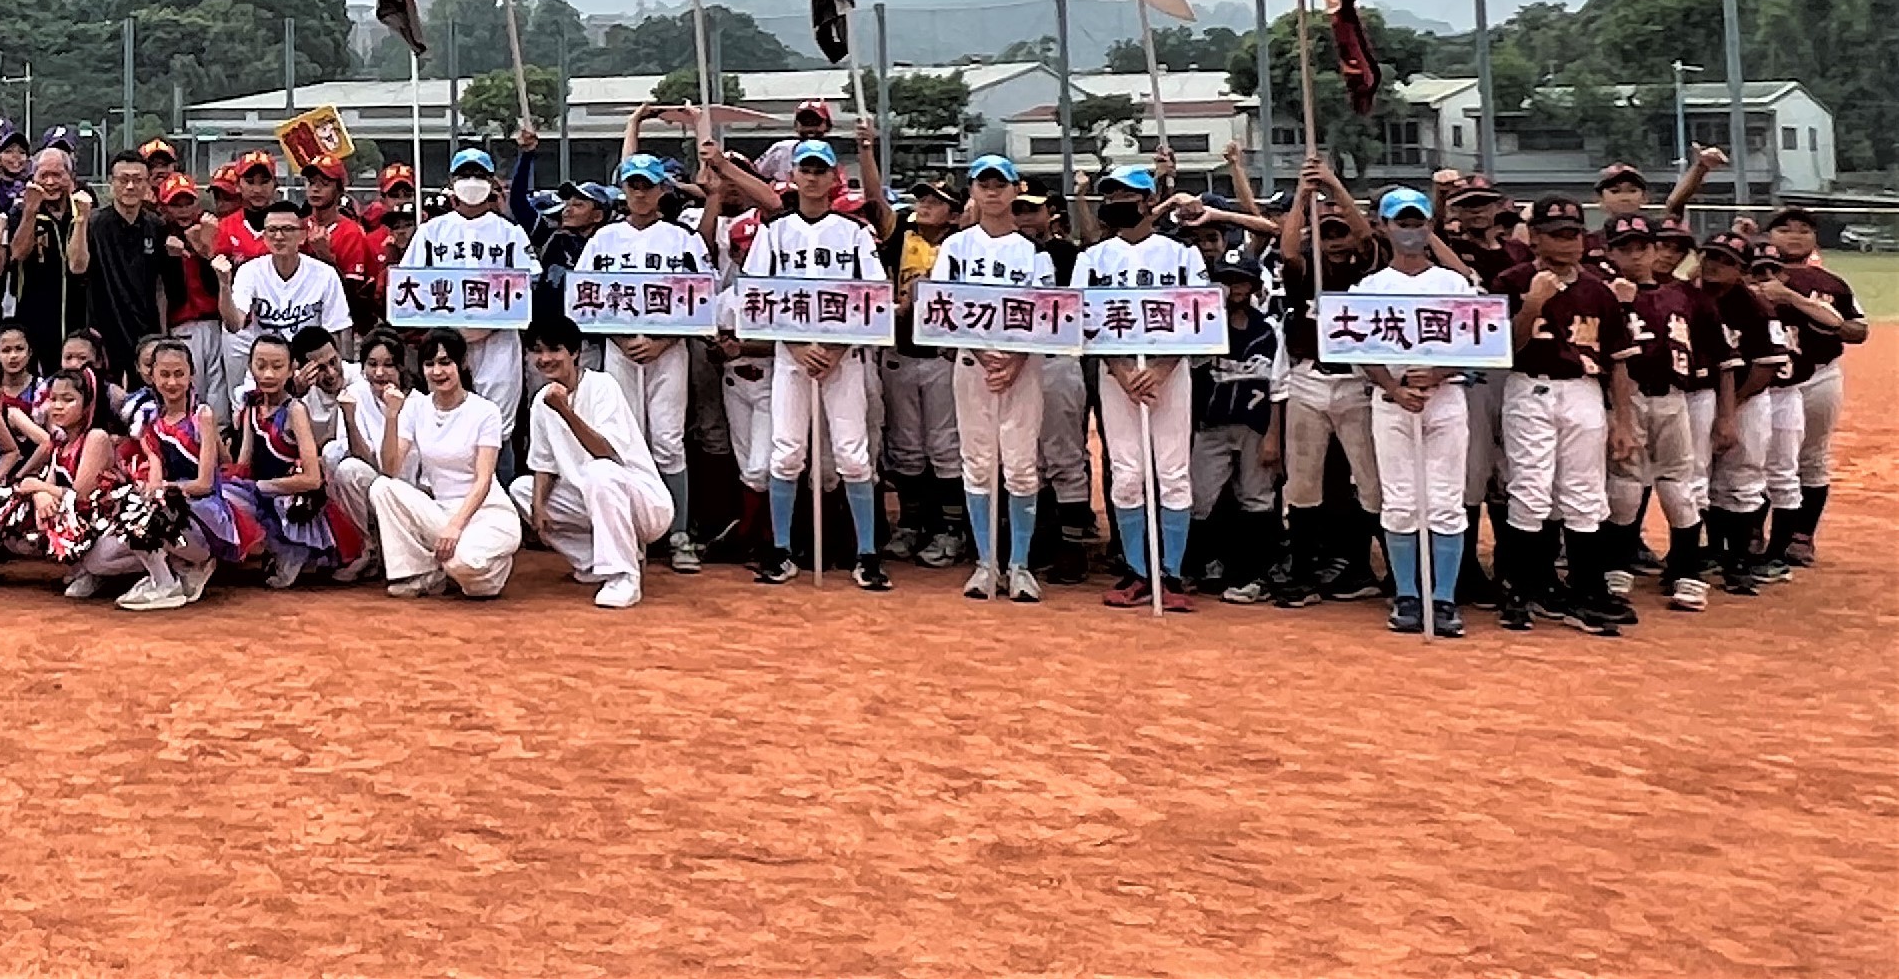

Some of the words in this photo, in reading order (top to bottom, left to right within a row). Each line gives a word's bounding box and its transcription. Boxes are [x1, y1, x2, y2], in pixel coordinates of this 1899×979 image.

[962, 257, 1028, 286] 正國中
[744, 287, 886, 327] 新埔國小
[923, 290, 1075, 335] 成功國小
[1329, 305, 1499, 351] 土城國小
